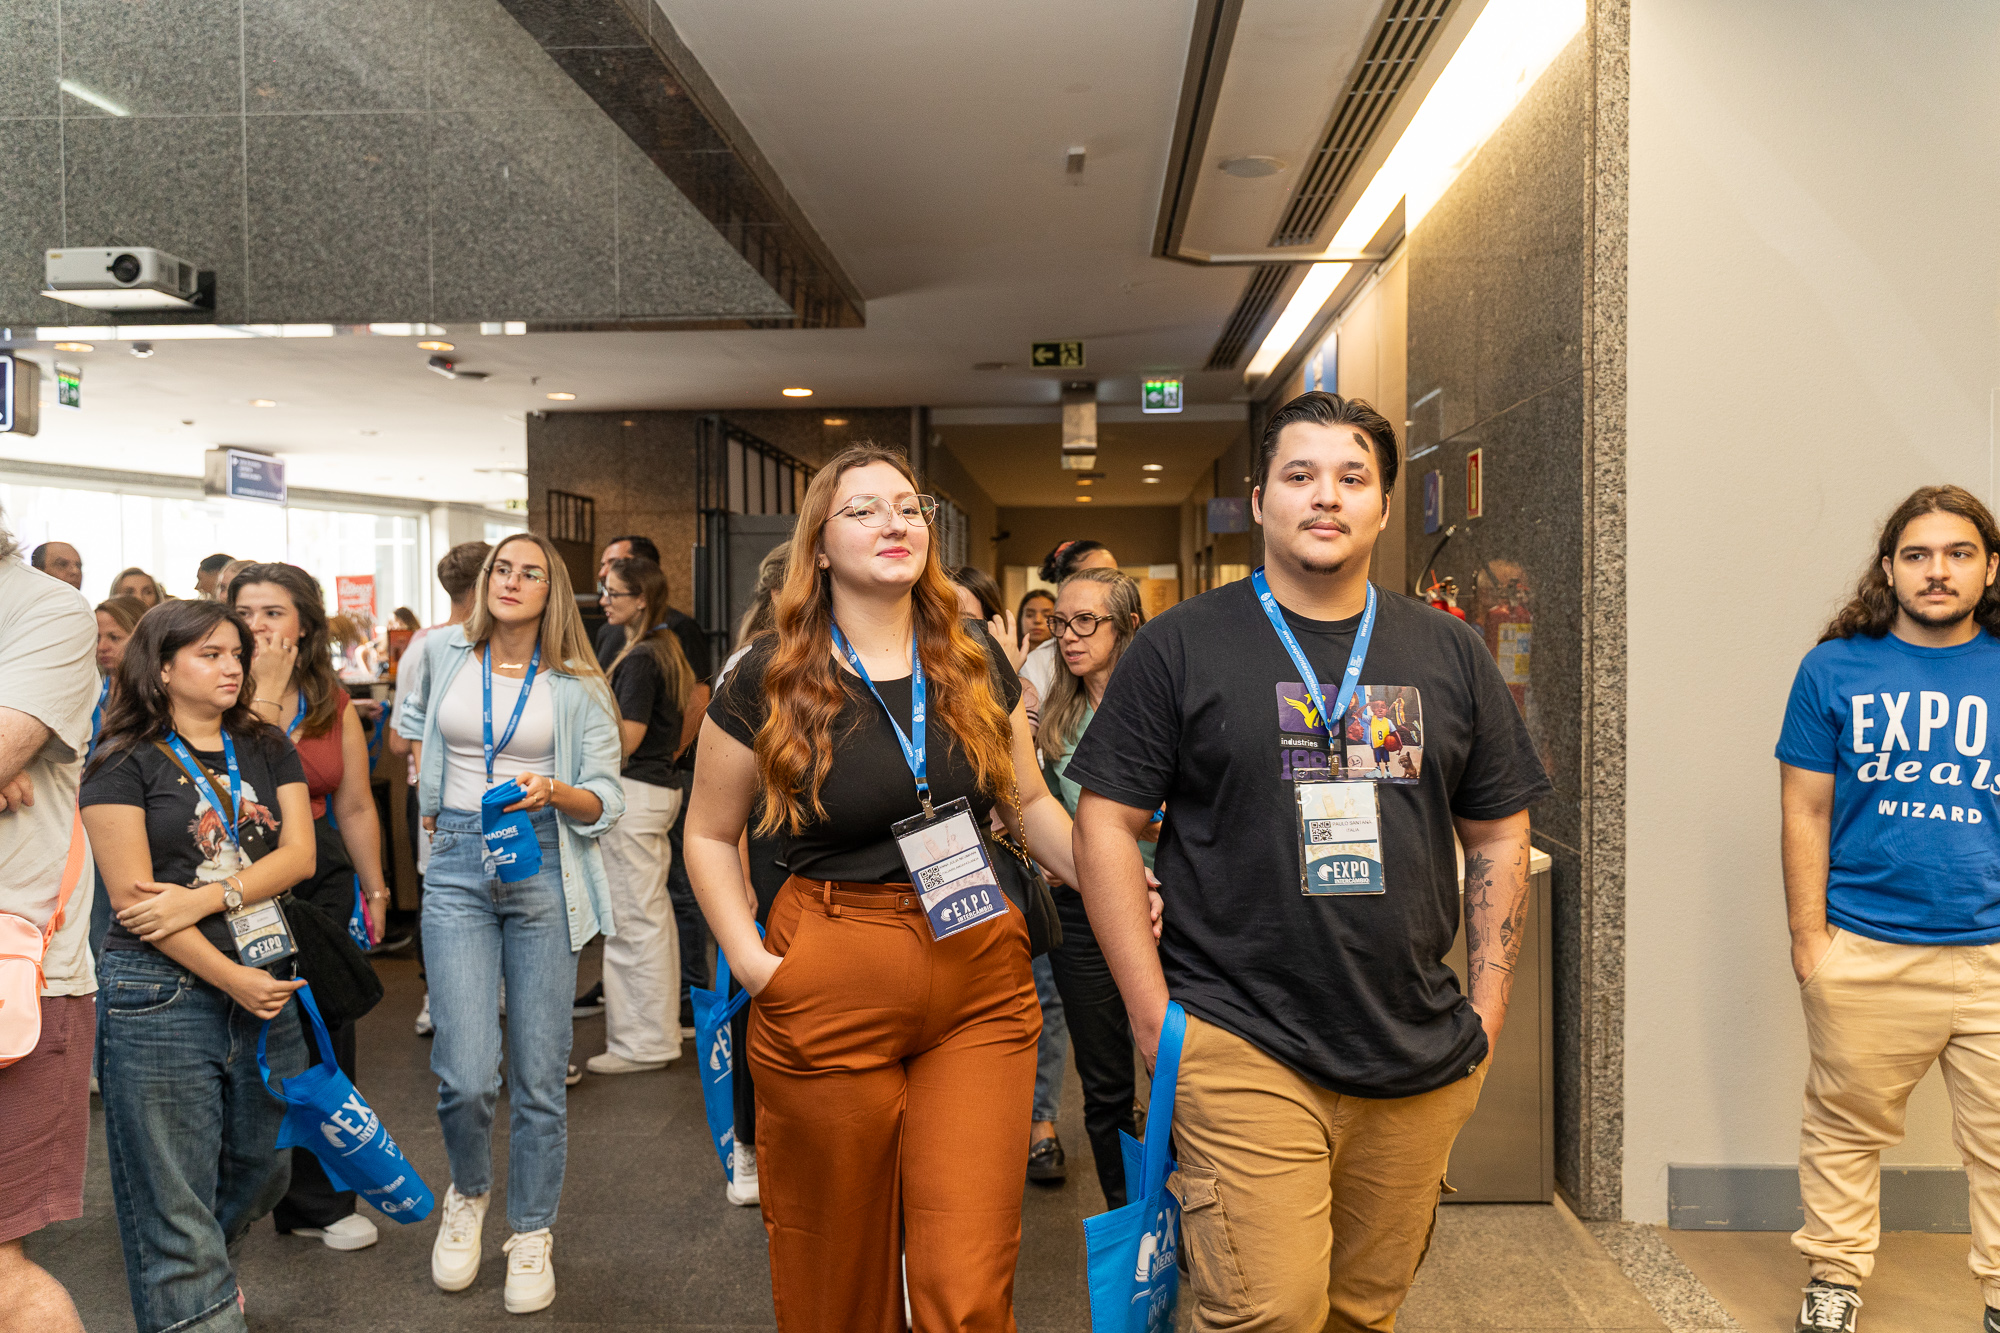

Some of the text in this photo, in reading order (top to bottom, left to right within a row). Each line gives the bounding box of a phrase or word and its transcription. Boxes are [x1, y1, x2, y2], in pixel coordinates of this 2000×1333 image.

[1282, 629, 1325, 711] www.expointercambio.com
[1378, 730, 1384, 741] 8
[1852, 691, 1988, 757] EXPO
[1281, 738, 1318, 748] industries
[1857, 752, 2000, 795] deals
[1878, 799, 1982, 824] WIZARD
[1333, 861, 1369, 878] EXPO
[951, 889, 990, 918] EXPO
[957, 903, 994, 922] INTERCAMBIO
[257, 935, 283, 954] EXPO
[330, 1086, 372, 1136] EX
[356, 1111, 379, 1142] INTER
